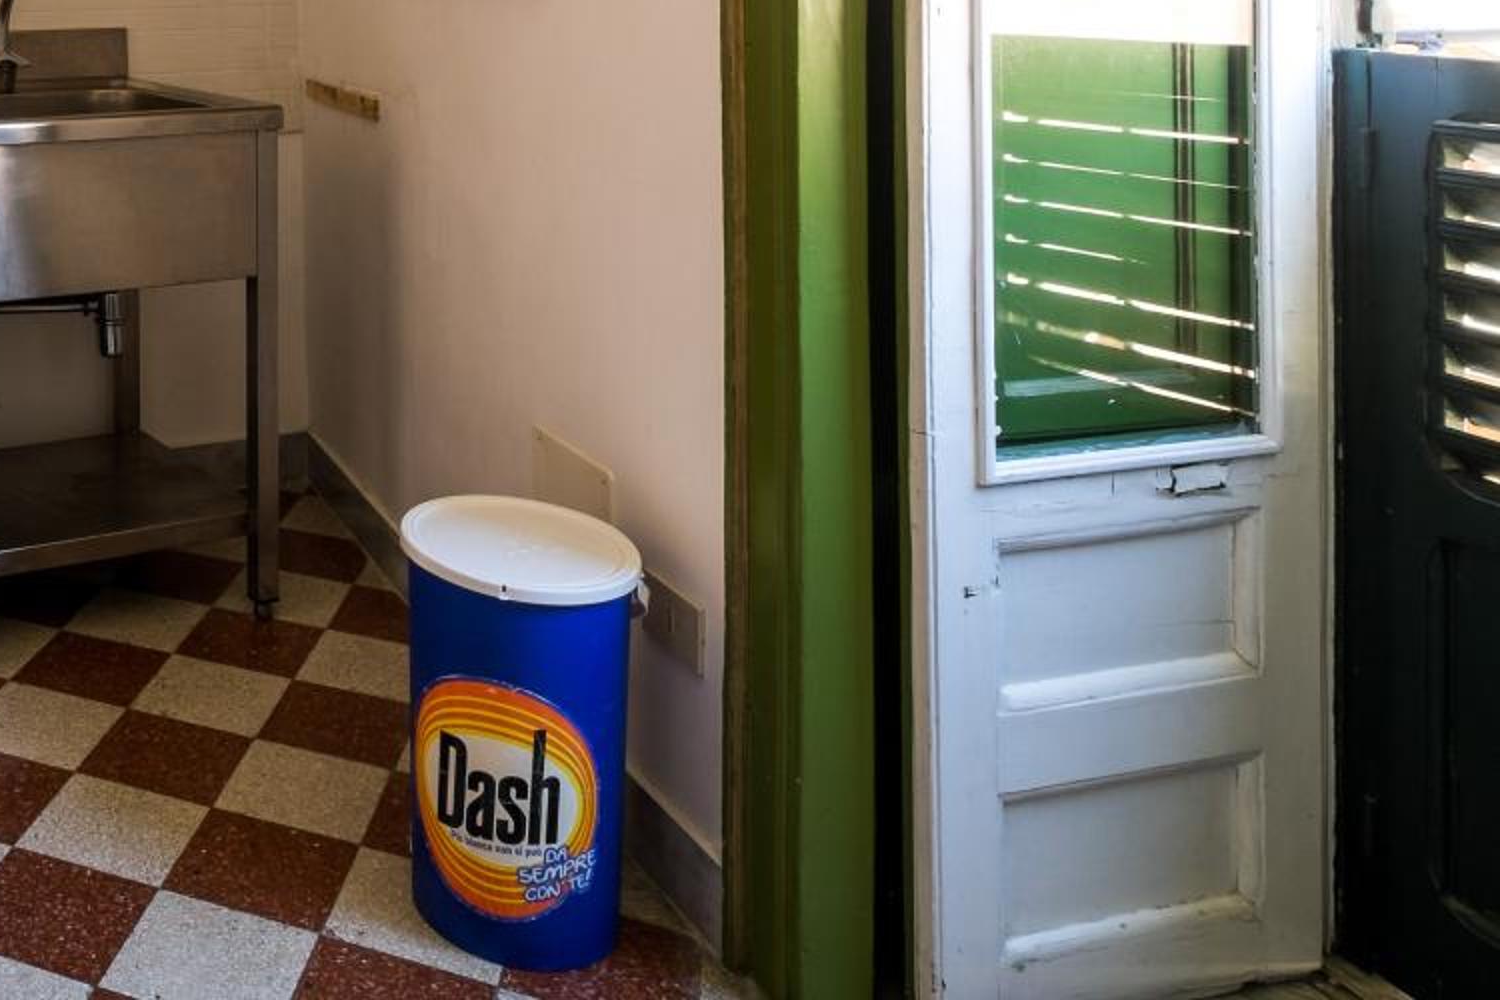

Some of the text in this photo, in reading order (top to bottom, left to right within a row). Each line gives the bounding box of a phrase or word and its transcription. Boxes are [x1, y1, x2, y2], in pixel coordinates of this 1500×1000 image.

[437, 729, 561, 846] Dash
[518, 849, 597, 884] SEMPRE
[545, 847, 568, 863] DA
[525, 867, 593, 901] CON TE!
